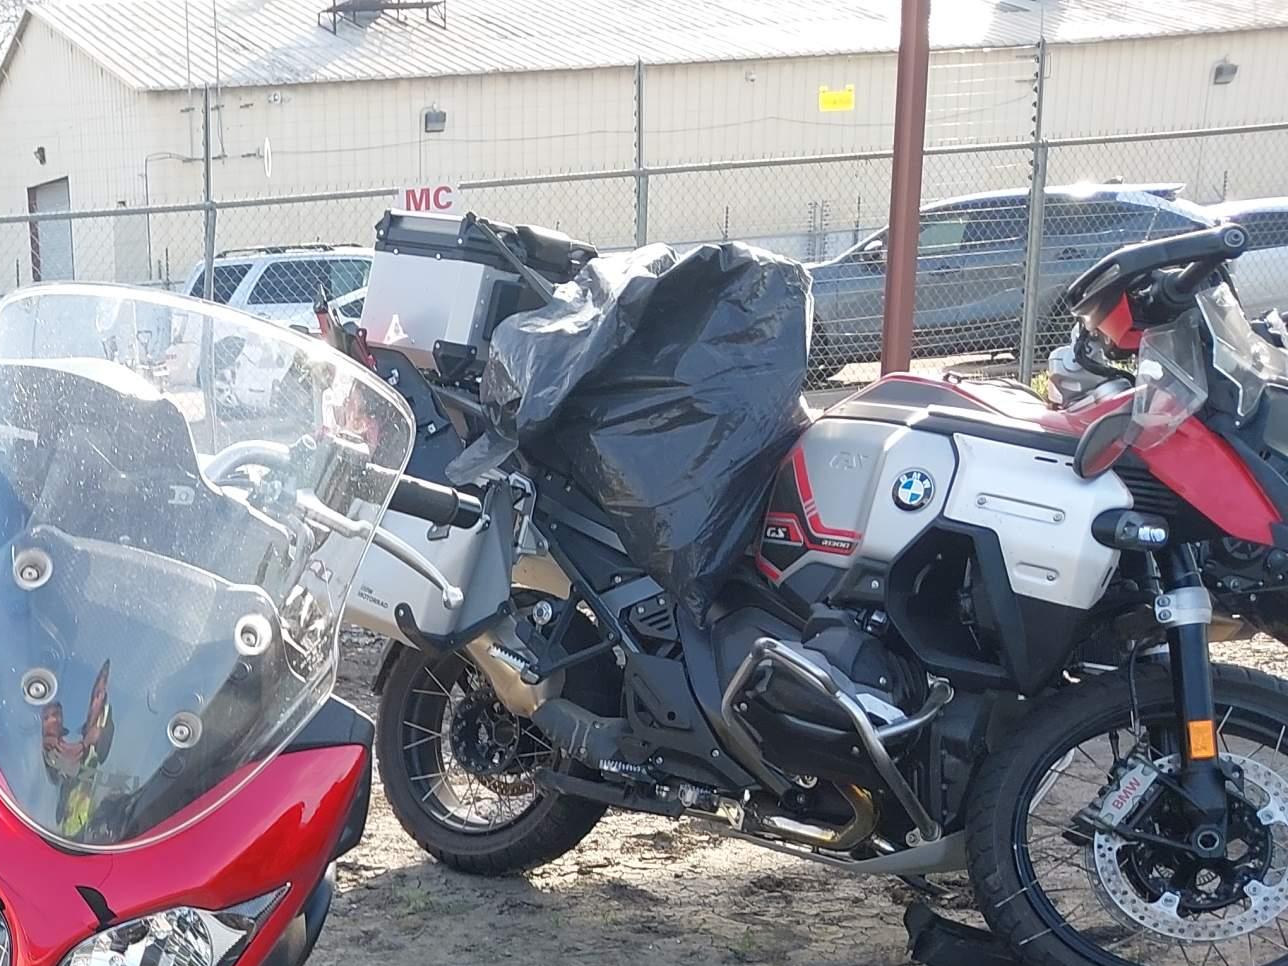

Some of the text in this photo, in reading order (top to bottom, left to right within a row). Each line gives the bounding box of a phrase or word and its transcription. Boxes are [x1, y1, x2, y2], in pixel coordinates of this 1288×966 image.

[405, 186, 453, 211] MC
[900, 471, 932, 489] BMW
[766, 527, 787, 539] GS
[1112, 777, 1141, 810] BMW
